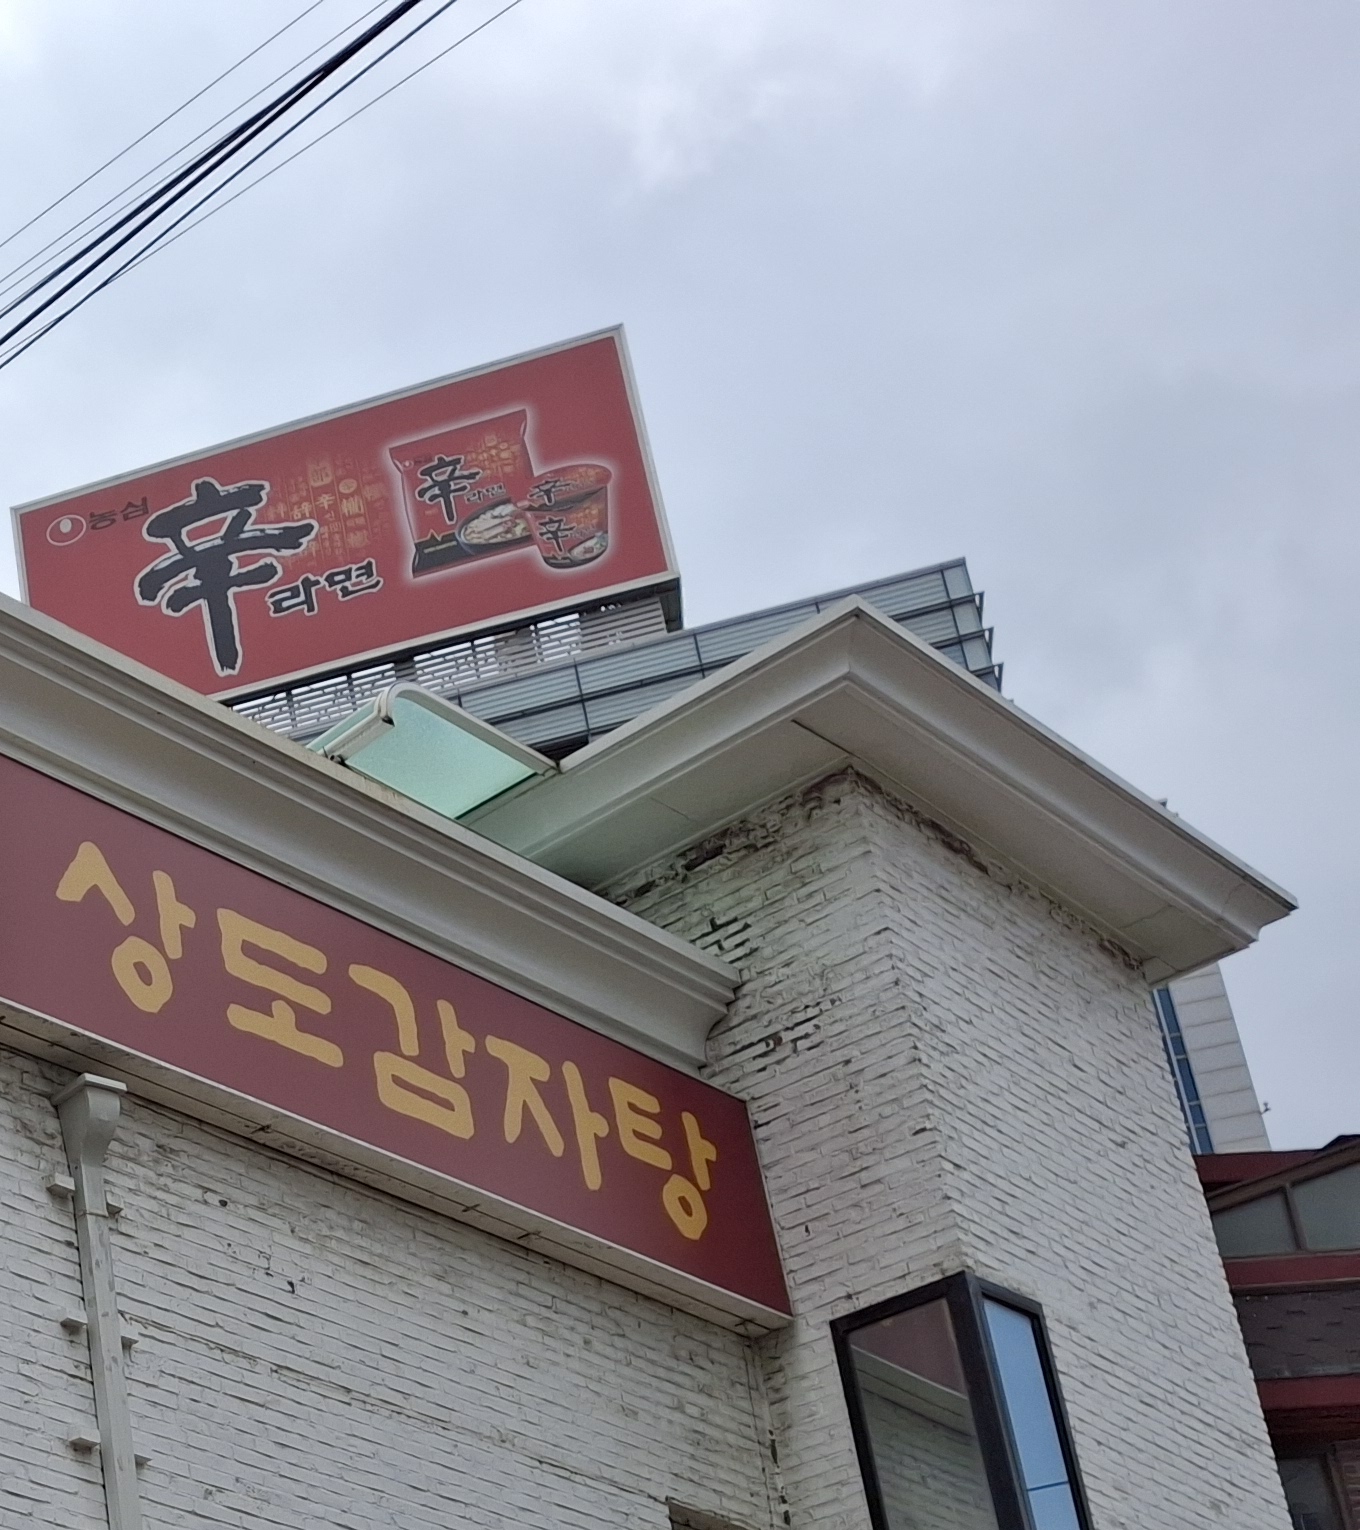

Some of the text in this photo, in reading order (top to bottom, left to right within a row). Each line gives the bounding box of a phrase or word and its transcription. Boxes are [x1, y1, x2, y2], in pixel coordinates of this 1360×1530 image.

[88, 496, 149, 531] 농심
[417, 454, 483, 524] 辛
[135, 478, 317, 676] 辛
[268, 557, 382, 616] 라면
[55, 840, 718, 1243] 상도감자탕
